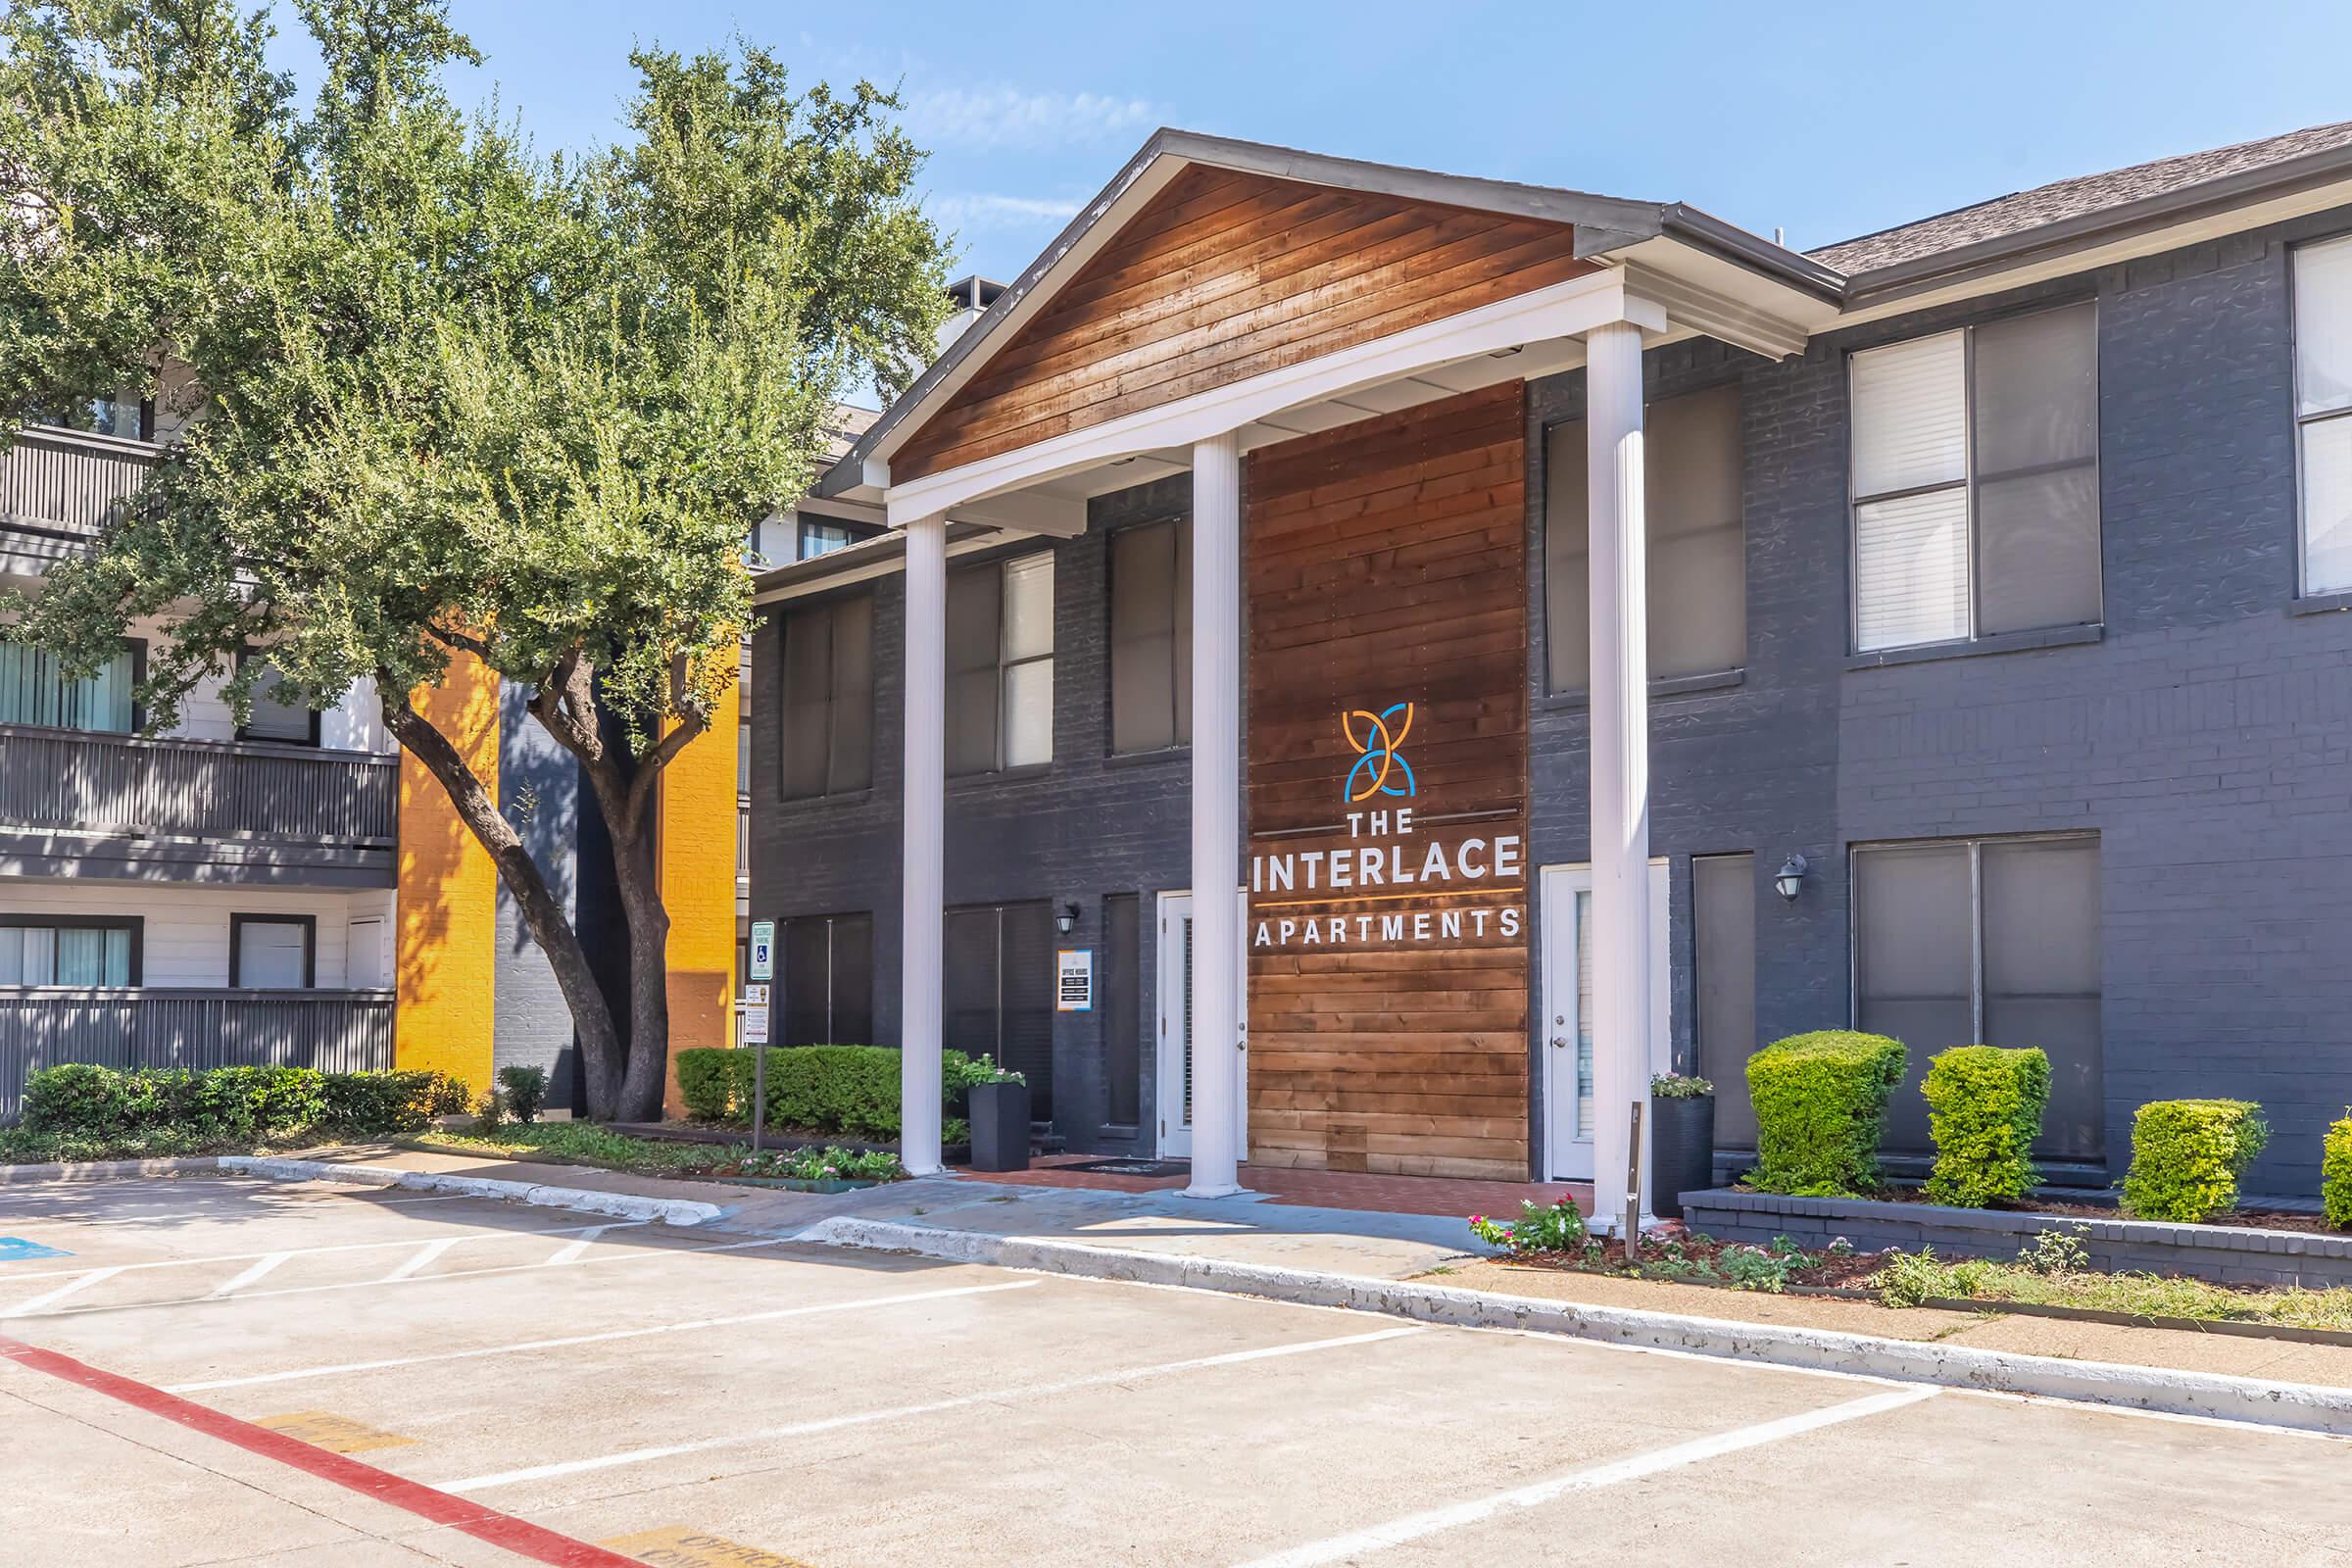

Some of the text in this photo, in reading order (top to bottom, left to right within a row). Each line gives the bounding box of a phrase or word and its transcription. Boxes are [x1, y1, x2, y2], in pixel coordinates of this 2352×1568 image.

[1347, 808, 1413, 839] THE
[1252, 836, 1520, 893] INTERLACE
[1254, 908, 1520, 947] APARTMENTS
